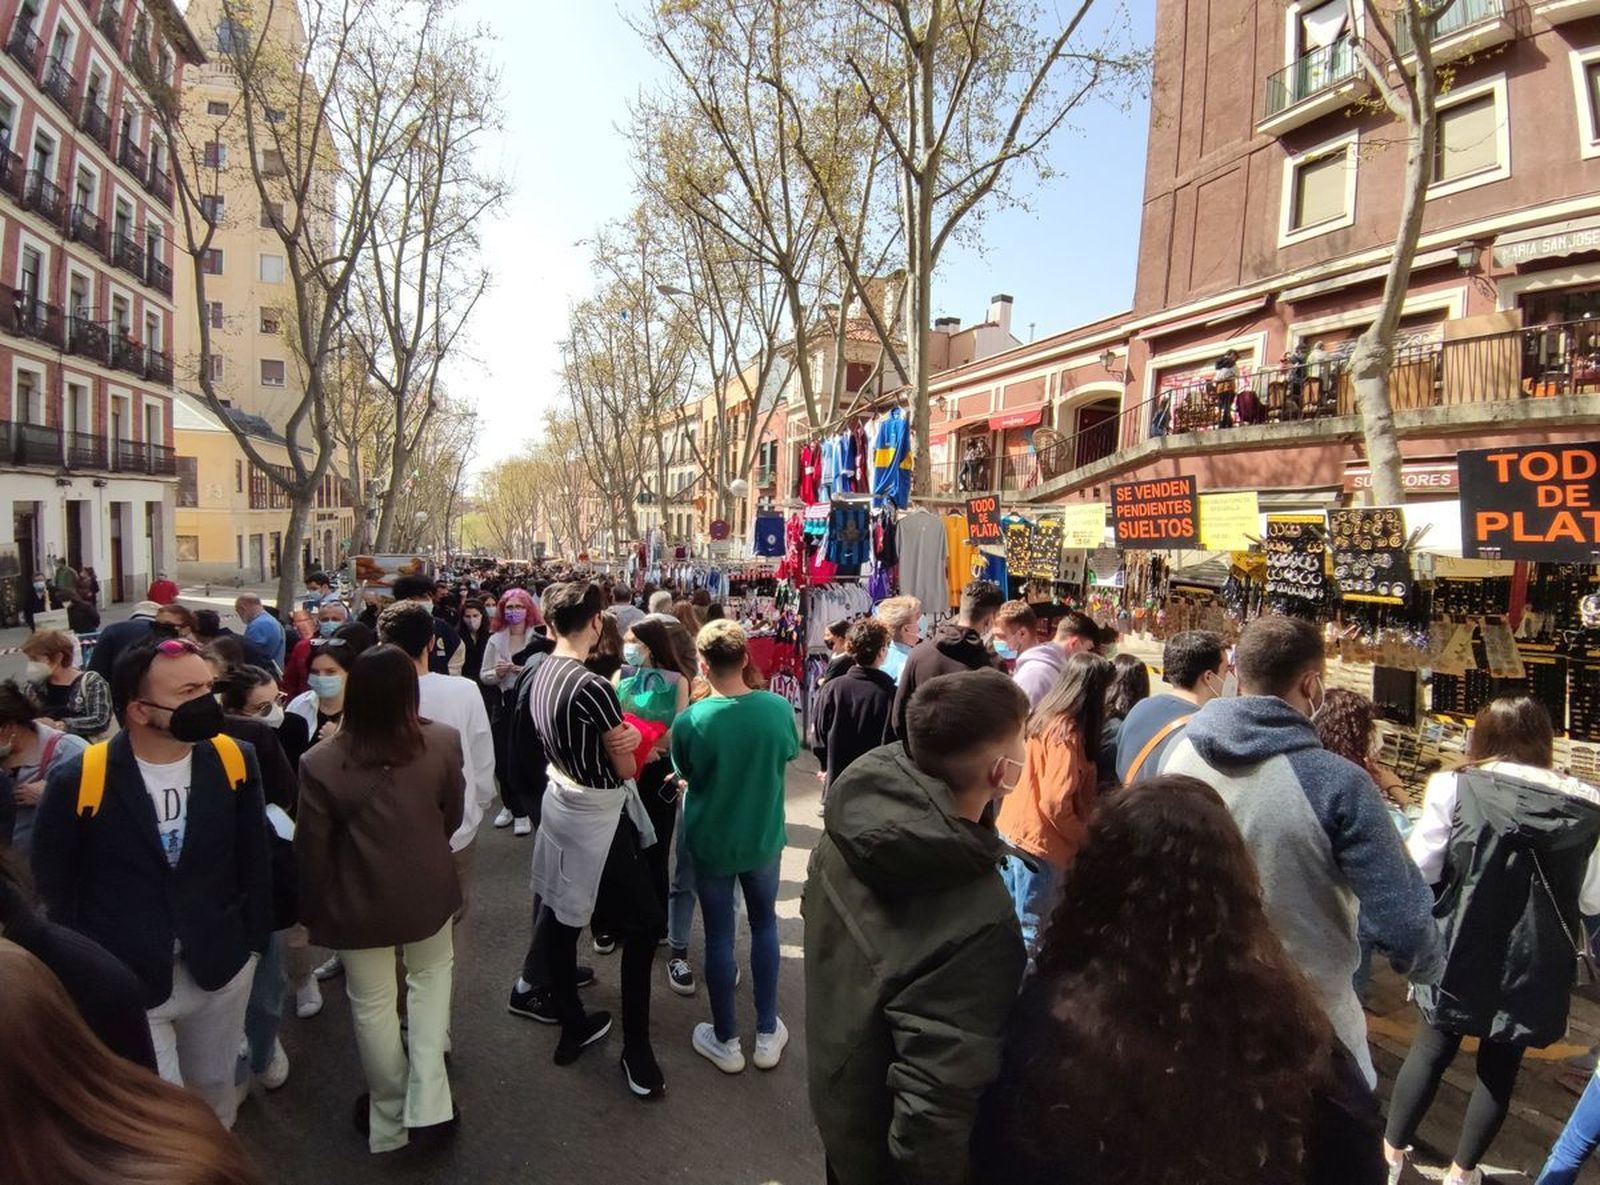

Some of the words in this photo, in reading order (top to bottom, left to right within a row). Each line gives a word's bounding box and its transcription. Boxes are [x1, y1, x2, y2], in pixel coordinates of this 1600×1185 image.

[1542, 235, 1567, 253] SAN
[1353, 473, 1452, 488] SUORES
[1116, 486, 1132, 501] SE
[1135, 479, 1190, 499] VENDEN
[1537, 484, 1590, 507] DE
[970, 498, 995, 513] TODO
[1116, 499, 1192, 518] PENDIENTES
[978, 512, 989, 523] DE
[970, 523, 1000, 537] PLATA
[1118, 517, 1194, 539] SUELTOS
